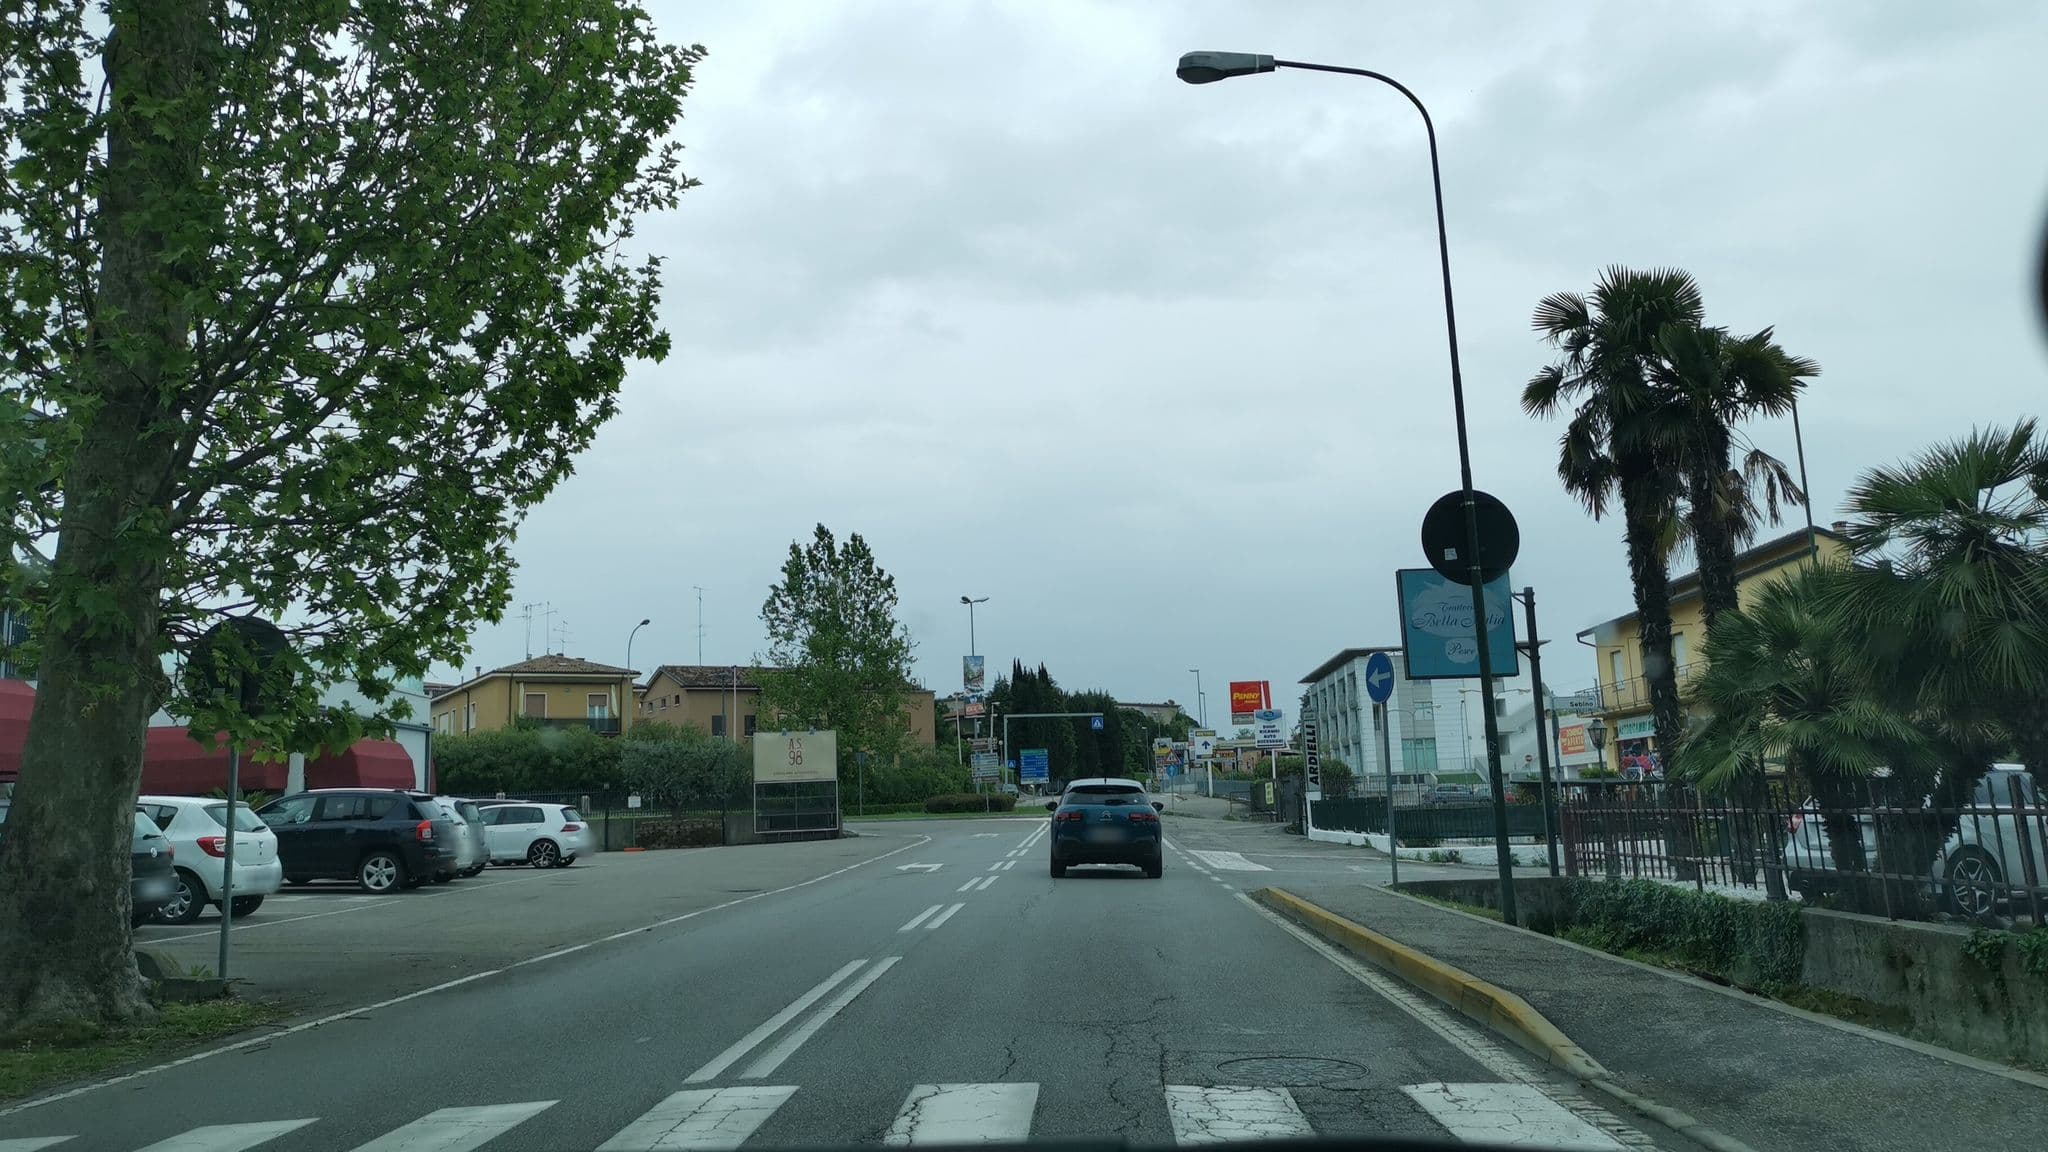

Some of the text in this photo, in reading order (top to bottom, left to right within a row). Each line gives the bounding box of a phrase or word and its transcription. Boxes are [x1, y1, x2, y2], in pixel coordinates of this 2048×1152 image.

[1411, 612, 1458, 630] Bella
[788, 750, 803, 766] 98
[1305, 724, 1319, 786] ARDIELLI
